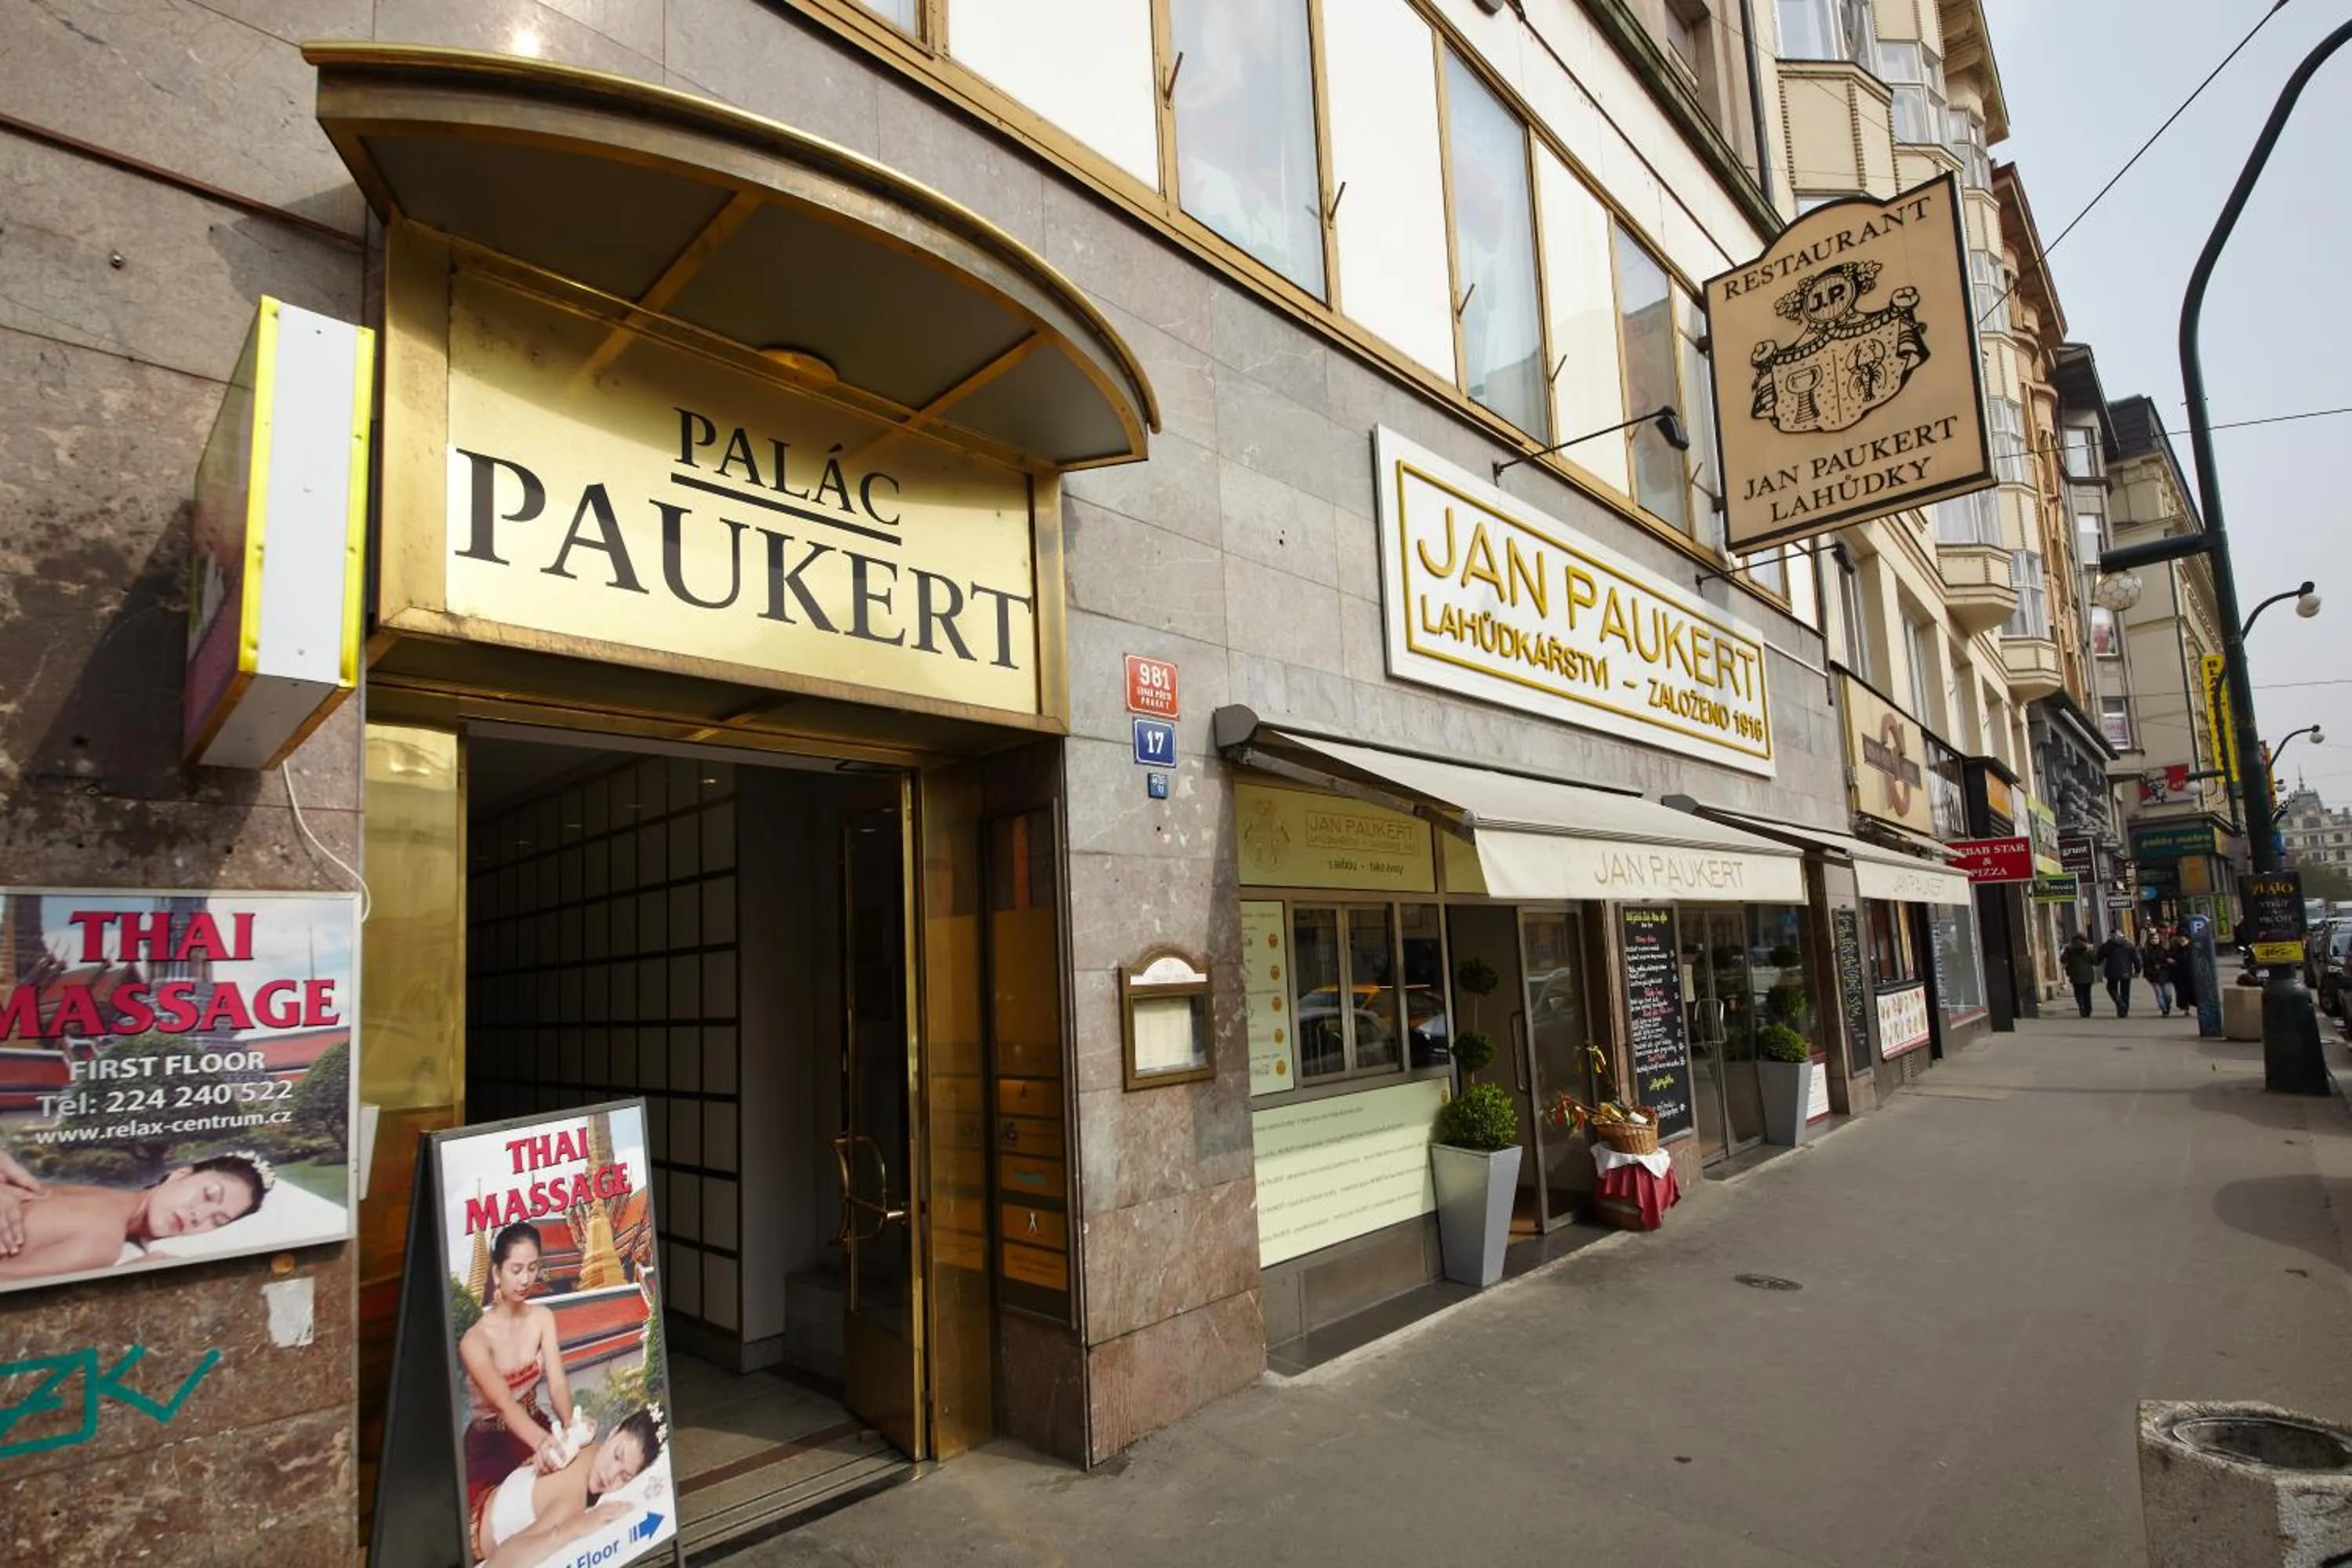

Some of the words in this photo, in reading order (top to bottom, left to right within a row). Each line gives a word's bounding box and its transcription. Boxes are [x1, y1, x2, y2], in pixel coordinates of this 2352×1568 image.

[1724, 196, 1931, 302] RESTAURANT
[673, 406, 902, 527] PALÁC
[1744, 465, 1798, 501] JAN
[1811, 415, 1958, 481] PAUKERT
[1770, 456, 1932, 523] LAHŮDKY
[454, 448, 1033, 670] PAUKERT
[1417, 506, 1548, 619] JAN
[1566, 564, 1756, 702] PAUKERT
[1139, 663, 1171, 690] 981
[1421, 593, 1610, 690] LAHŮDKÁŘSTVÍ
[1648, 678, 1730, 731] ZALOŽENO
[1733, 710, 1763, 742] 1916
[1147, 730, 1164, 754] 17
[1309, 815, 1341, 833] JAN
[1594, 851, 1644, 888] JAN
[1651, 858, 1744, 889] PAUKERT
[1954, 846, 1990, 856] EBAB
[1994, 844, 2024, 854] STAR
[1971, 867, 2007, 877] PIZZA
[70, 911, 256, 962] THAI
[0, 978, 340, 1041] MASSAGE
[69, 1058, 158, 1082] FIRST
[165, 1051, 265, 1077] FLOOR
[37, 1094, 98, 1119] Tel:
[105, 1088, 165, 1113] 224
[172, 1083, 233, 1109] 240
[241, 1080, 293, 1102] 522
[35, 1109, 292, 1145] www.relax-centrum.cz
[506, 1127, 590, 1174] THAI
[464, 1162, 633, 1236] MASSAGE
